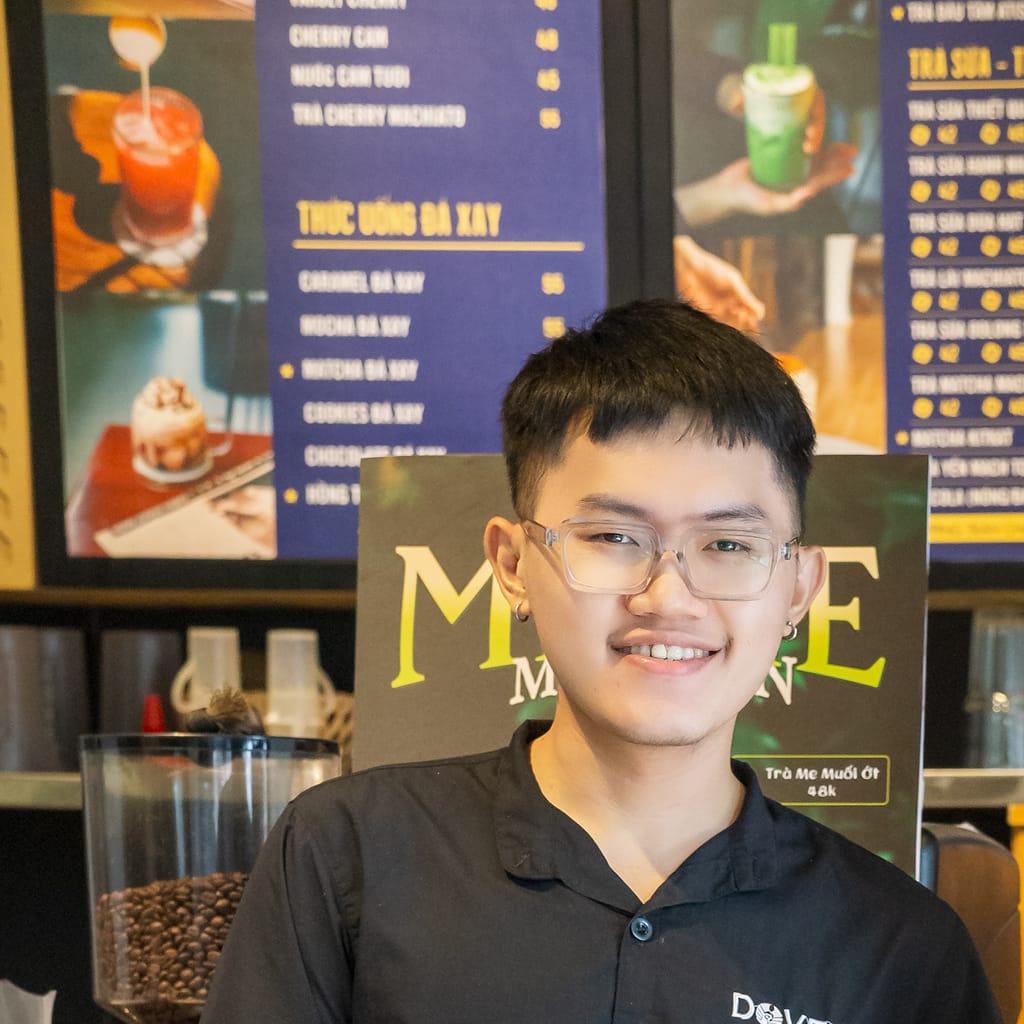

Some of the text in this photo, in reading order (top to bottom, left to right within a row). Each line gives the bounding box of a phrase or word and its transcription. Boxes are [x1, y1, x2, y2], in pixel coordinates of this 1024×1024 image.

[907, 44, 948, 79] TRÀ
[456, 202, 502, 237] XAY
[766, 766, 792, 780] Trà
[795, 768, 818, 780] Me
[821, 765, 857, 780] Muối
[808, 785, 836, 797] 48k
